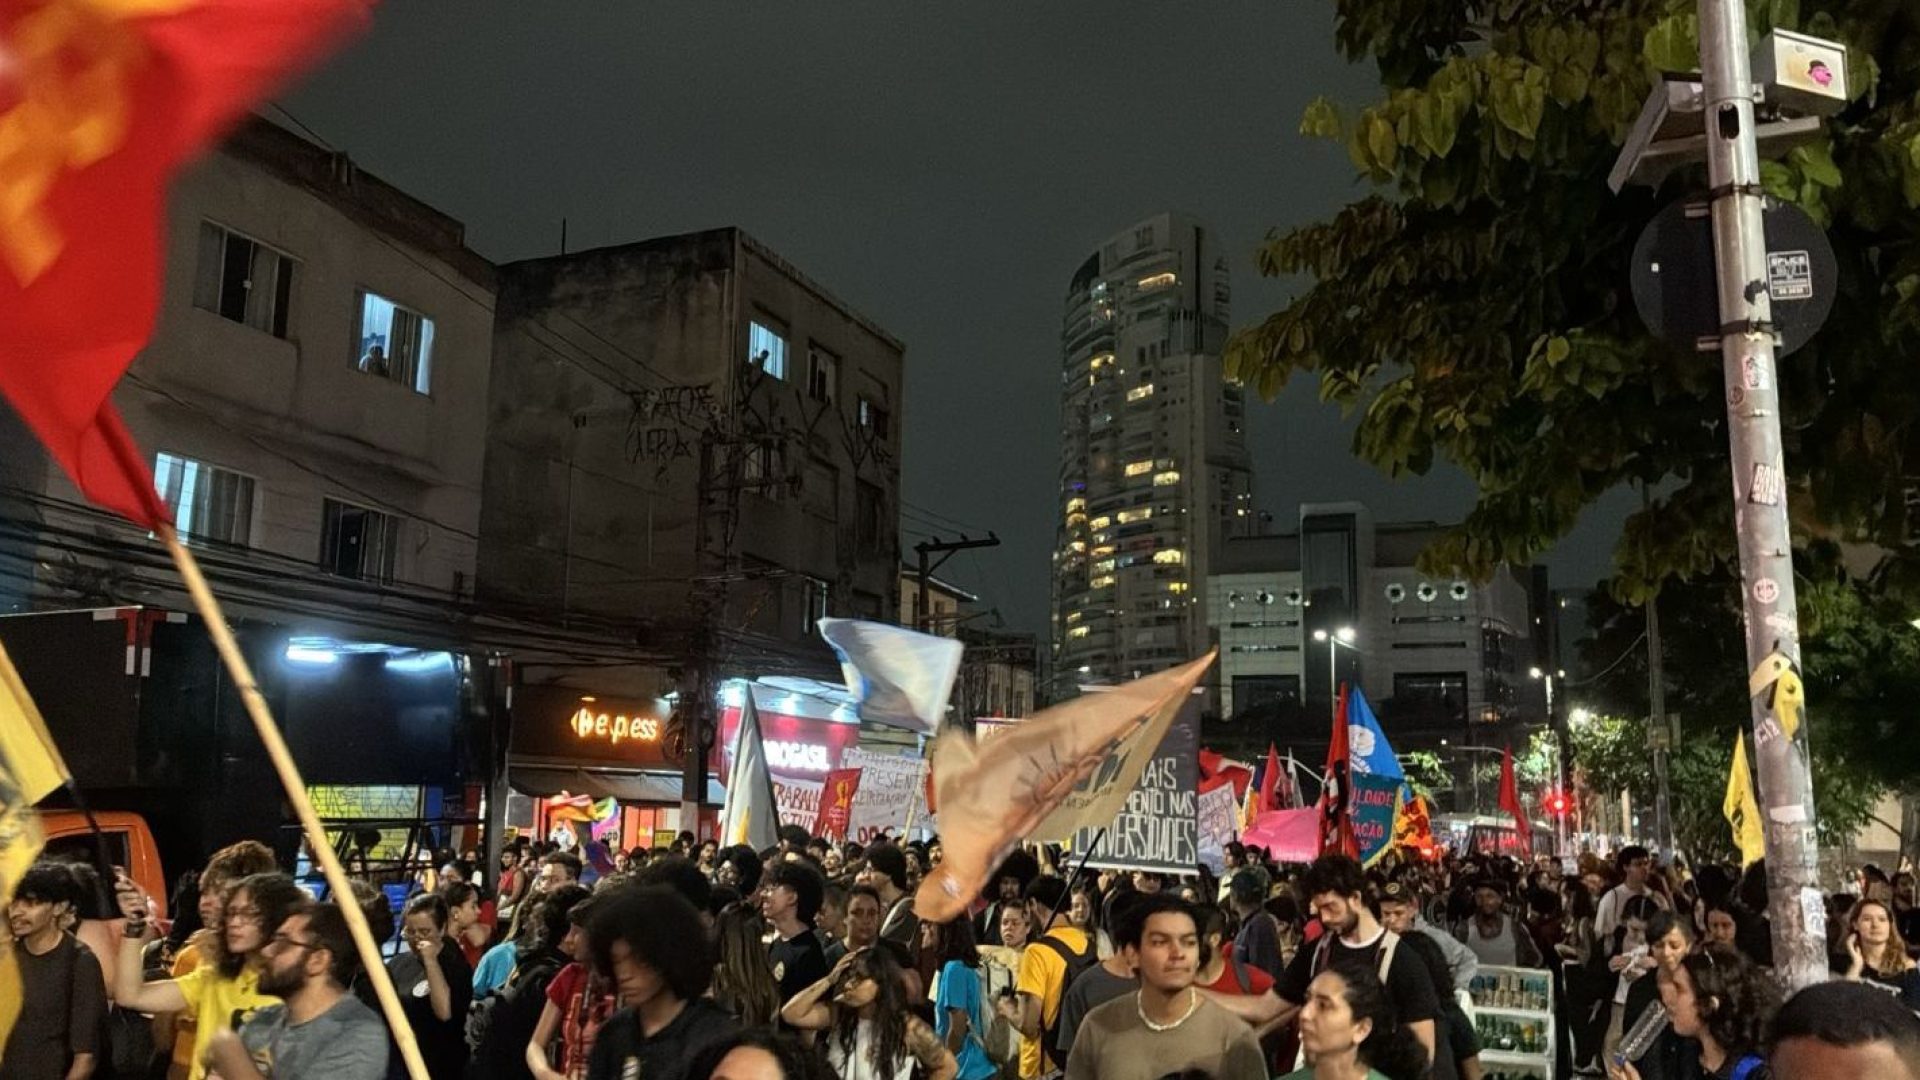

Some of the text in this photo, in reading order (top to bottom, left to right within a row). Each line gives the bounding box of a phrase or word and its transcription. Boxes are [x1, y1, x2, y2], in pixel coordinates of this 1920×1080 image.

[1169, 790, 1196, 818] NAS
[1075, 813, 1196, 865] UNIVERSIDADES
[1352, 820, 1384, 840] AÇÃO
